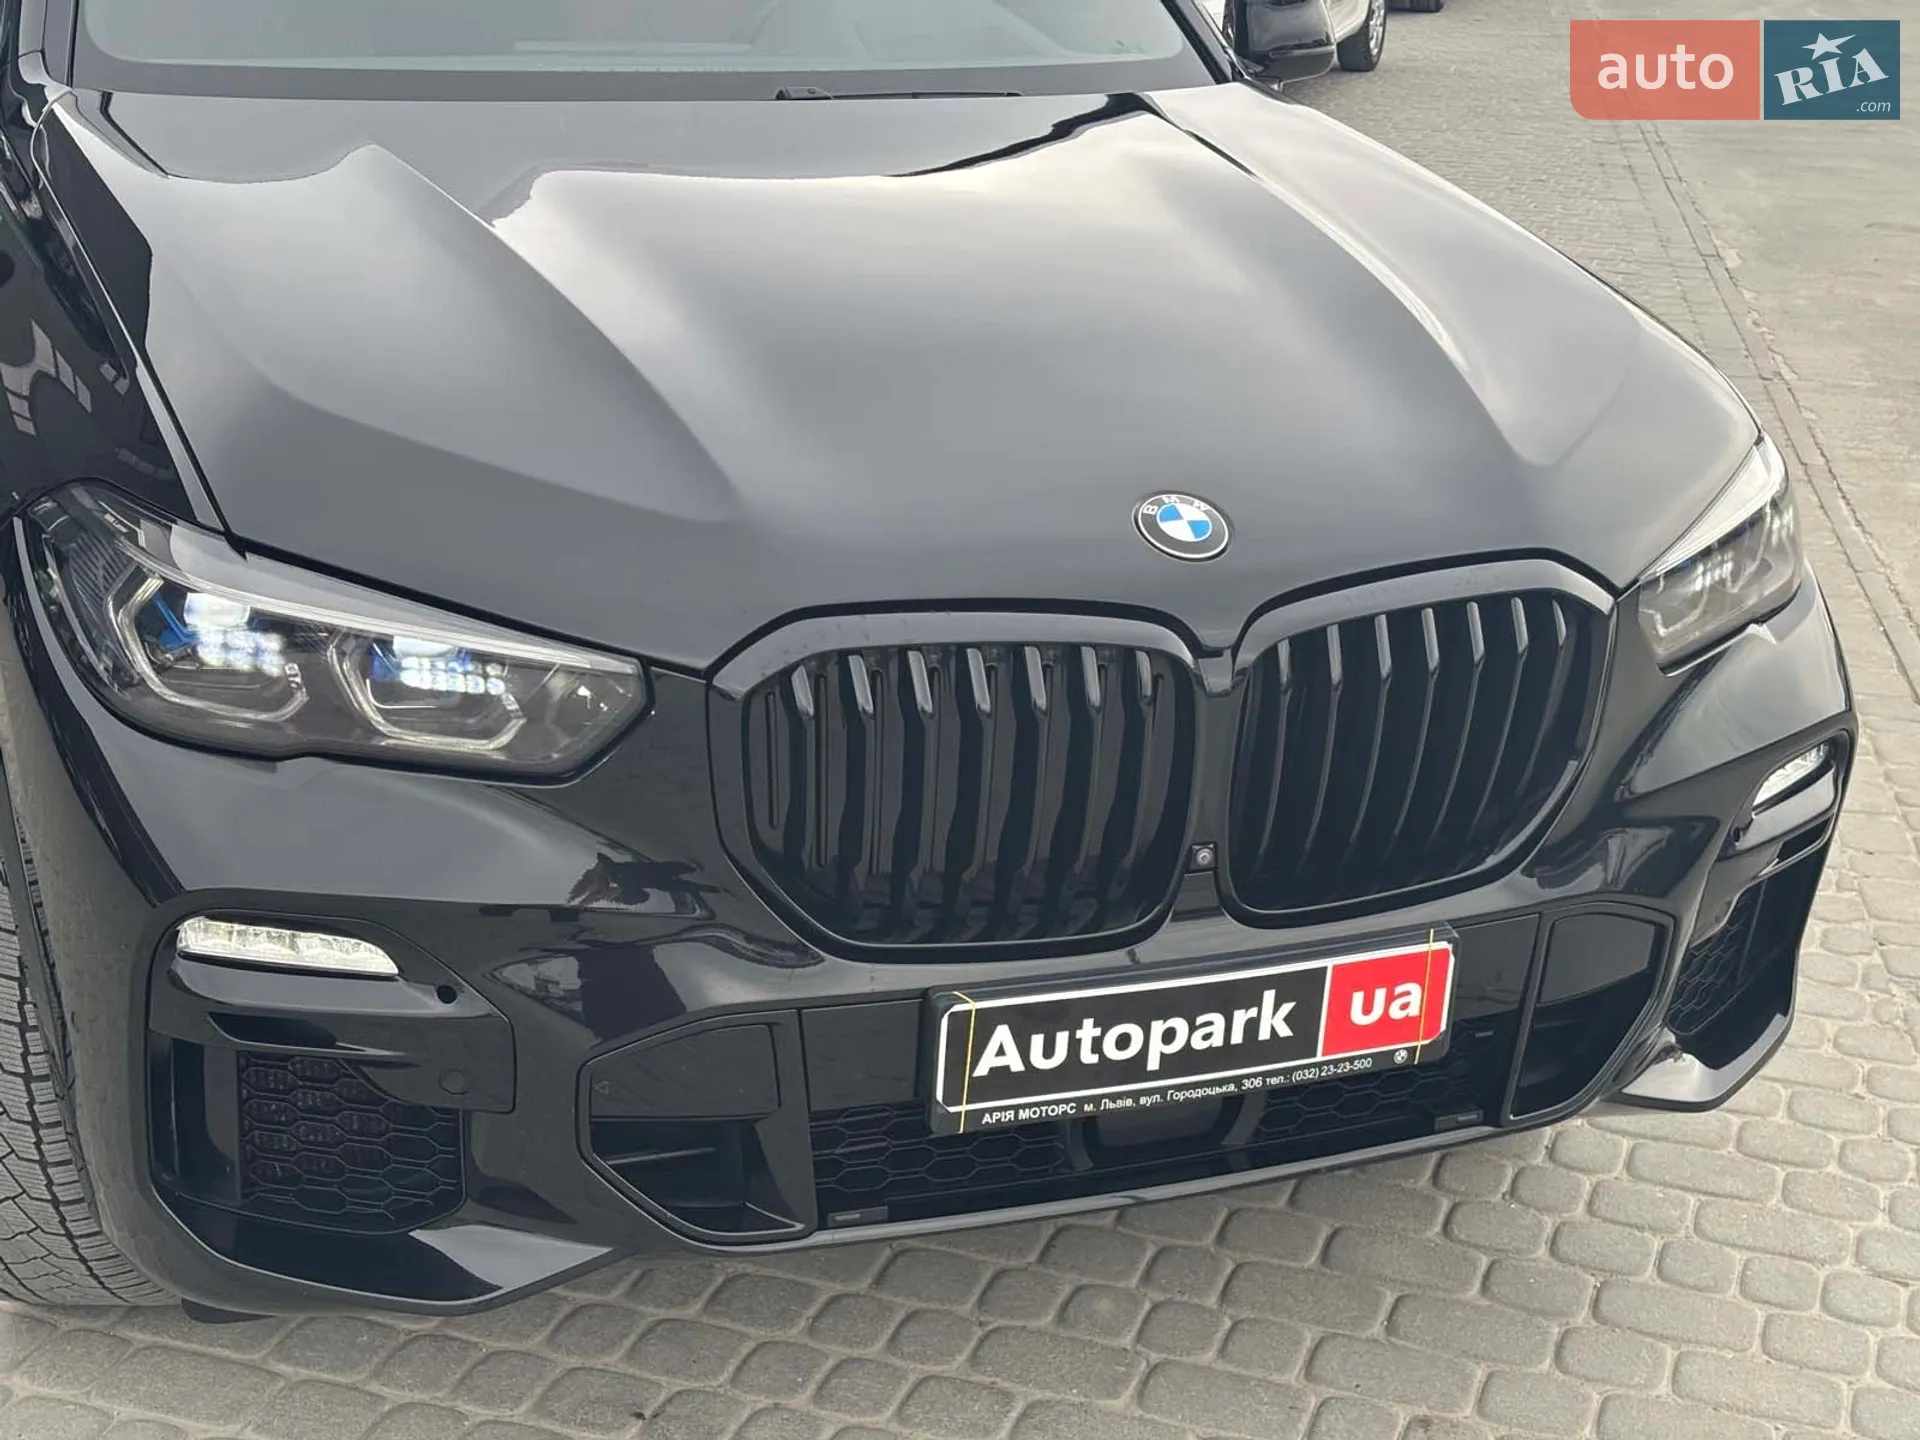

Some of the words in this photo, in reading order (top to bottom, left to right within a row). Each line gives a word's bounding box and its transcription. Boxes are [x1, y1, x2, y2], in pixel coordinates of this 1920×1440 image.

[972, 989, 1297, 1077] Autopark
[1350, 981, 1422, 1027] ua
[982, 1109, 1015, 1125] АРІЯ
[1018, 1102, 1077, 1120] МОТОРС
[1084, 1102, 1097, 1113] м.
[1100, 1096, 1136, 1111] Львів,
[1139, 1093, 1163, 1106] вул.
[1166, 1084, 1238, 1103] Городоцька,
[1241, 1078, 1263, 1091] 306
[1266, 1074, 1290, 1087] тел.:
[1292, 1066, 1320, 1084] (032)
[1320, 1057, 1373, 1077] 23-23-500
